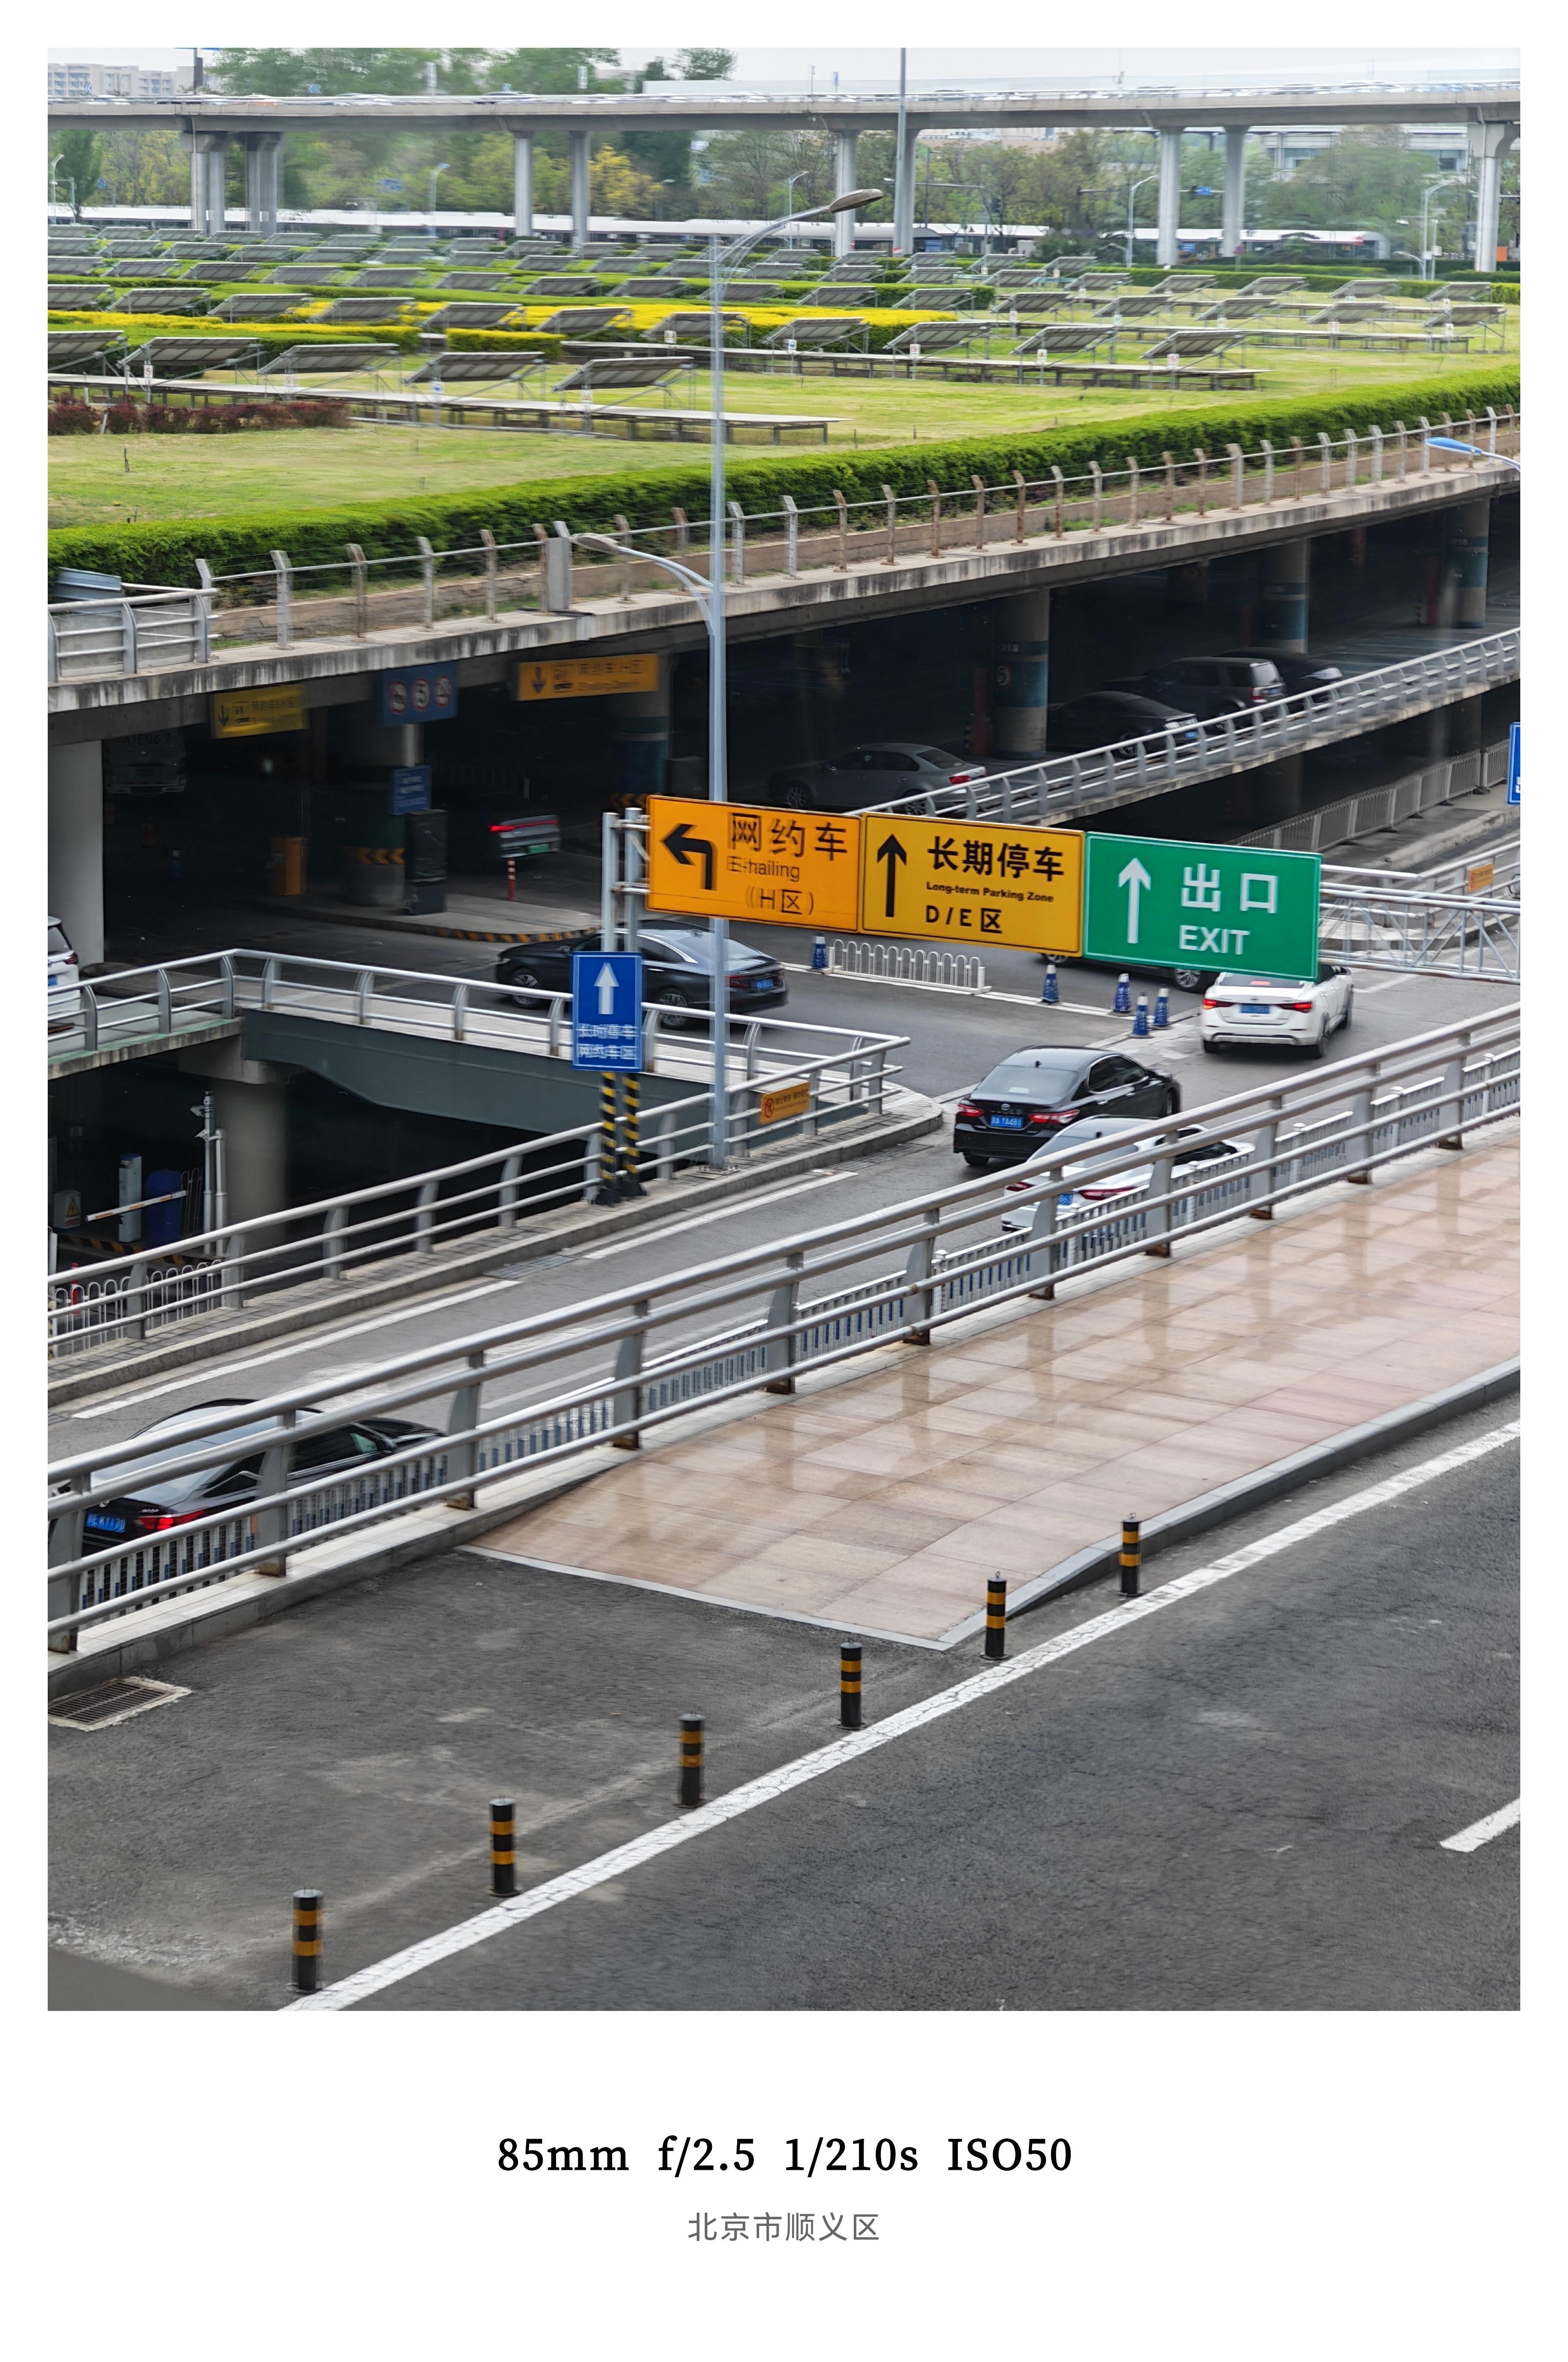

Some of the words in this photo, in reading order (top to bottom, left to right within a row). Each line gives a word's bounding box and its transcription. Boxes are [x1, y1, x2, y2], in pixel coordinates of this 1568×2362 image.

[727, 812, 847, 861] 网约车
[726, 856, 800, 882] E-hailing
[927, 836, 1064, 882] 长期停车
[926, 881, 980, 895] Long-term
[983, 888, 1024, 901] Parking
[1027, 892, 1054, 902] Zone
[1181, 863, 1278, 913] 出口
[1179, 925, 1251, 955] EXIT
